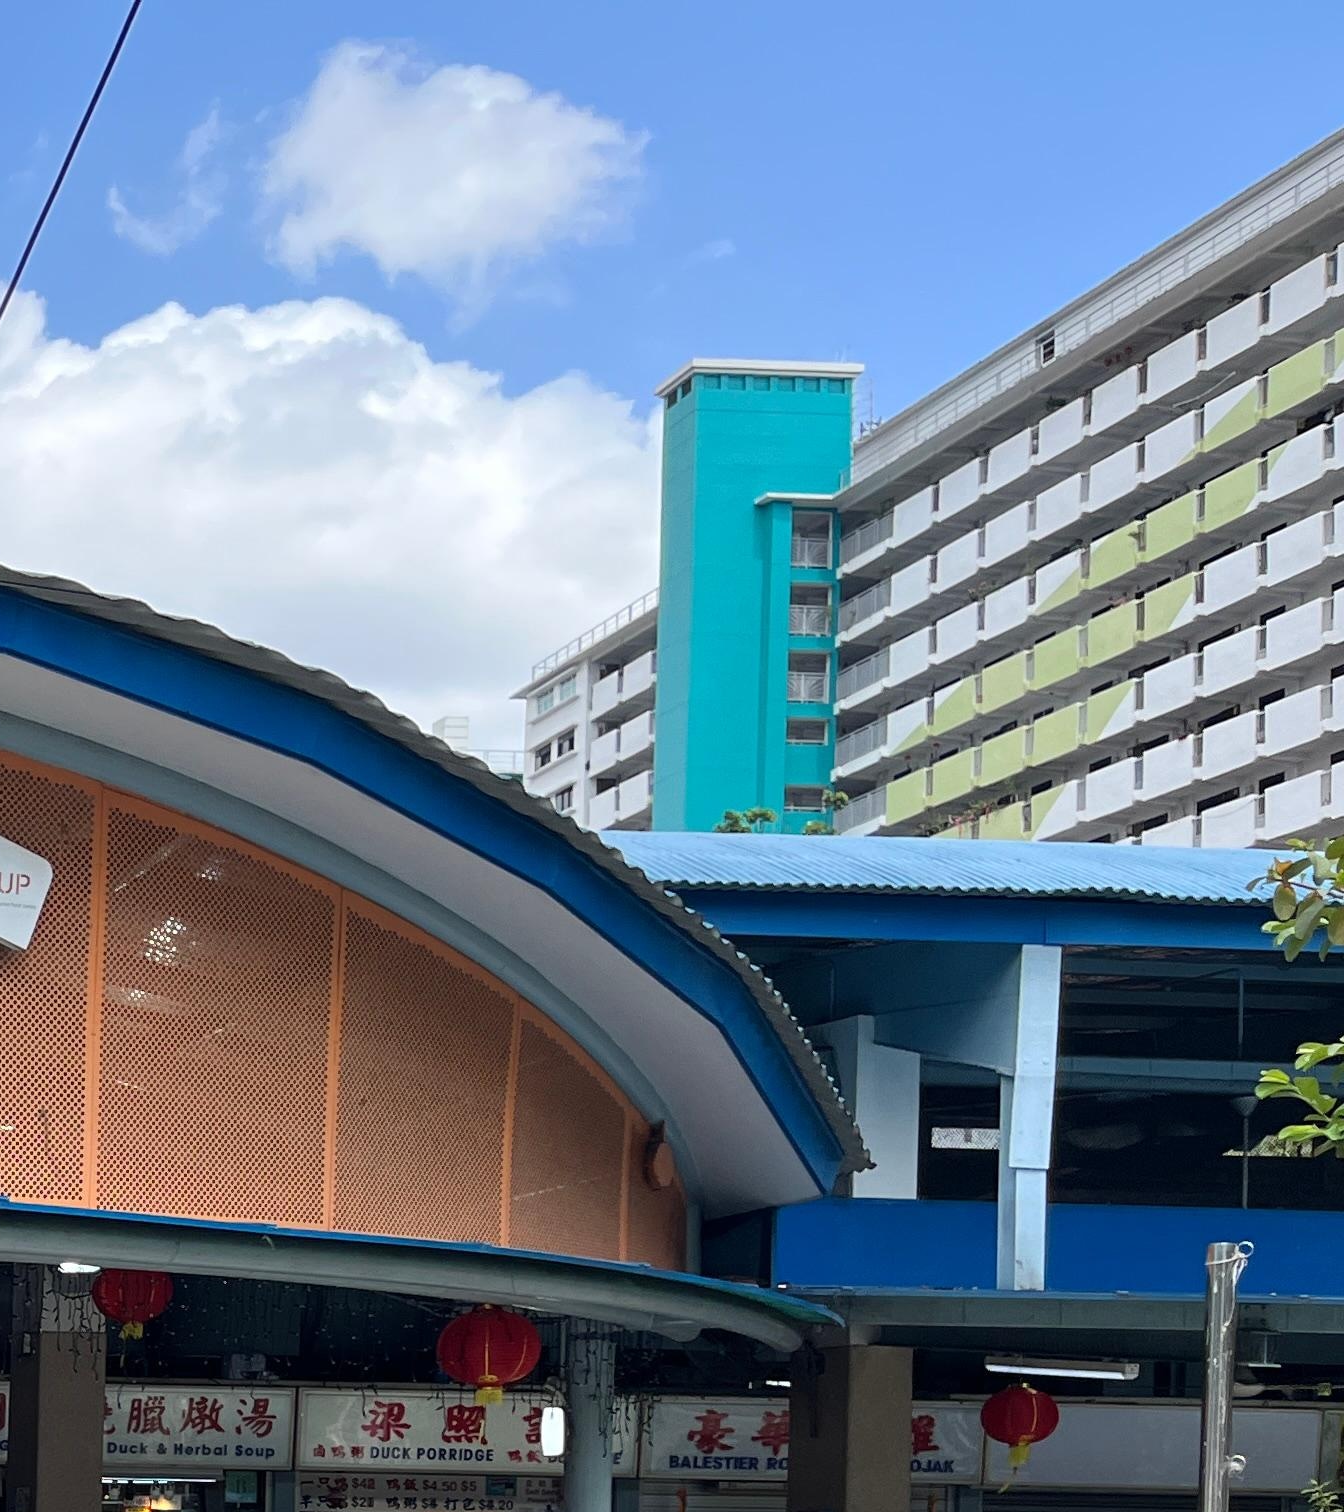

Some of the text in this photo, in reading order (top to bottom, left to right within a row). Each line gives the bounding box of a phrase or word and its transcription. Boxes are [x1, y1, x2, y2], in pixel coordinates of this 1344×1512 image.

[107, 1442, 276, 1459] Duck & Herbal Soup
[370, 1446, 494, 1462] DUCK PORRIDGE
[669, 1455, 954, 1473] BALESTIER RO OJAK
